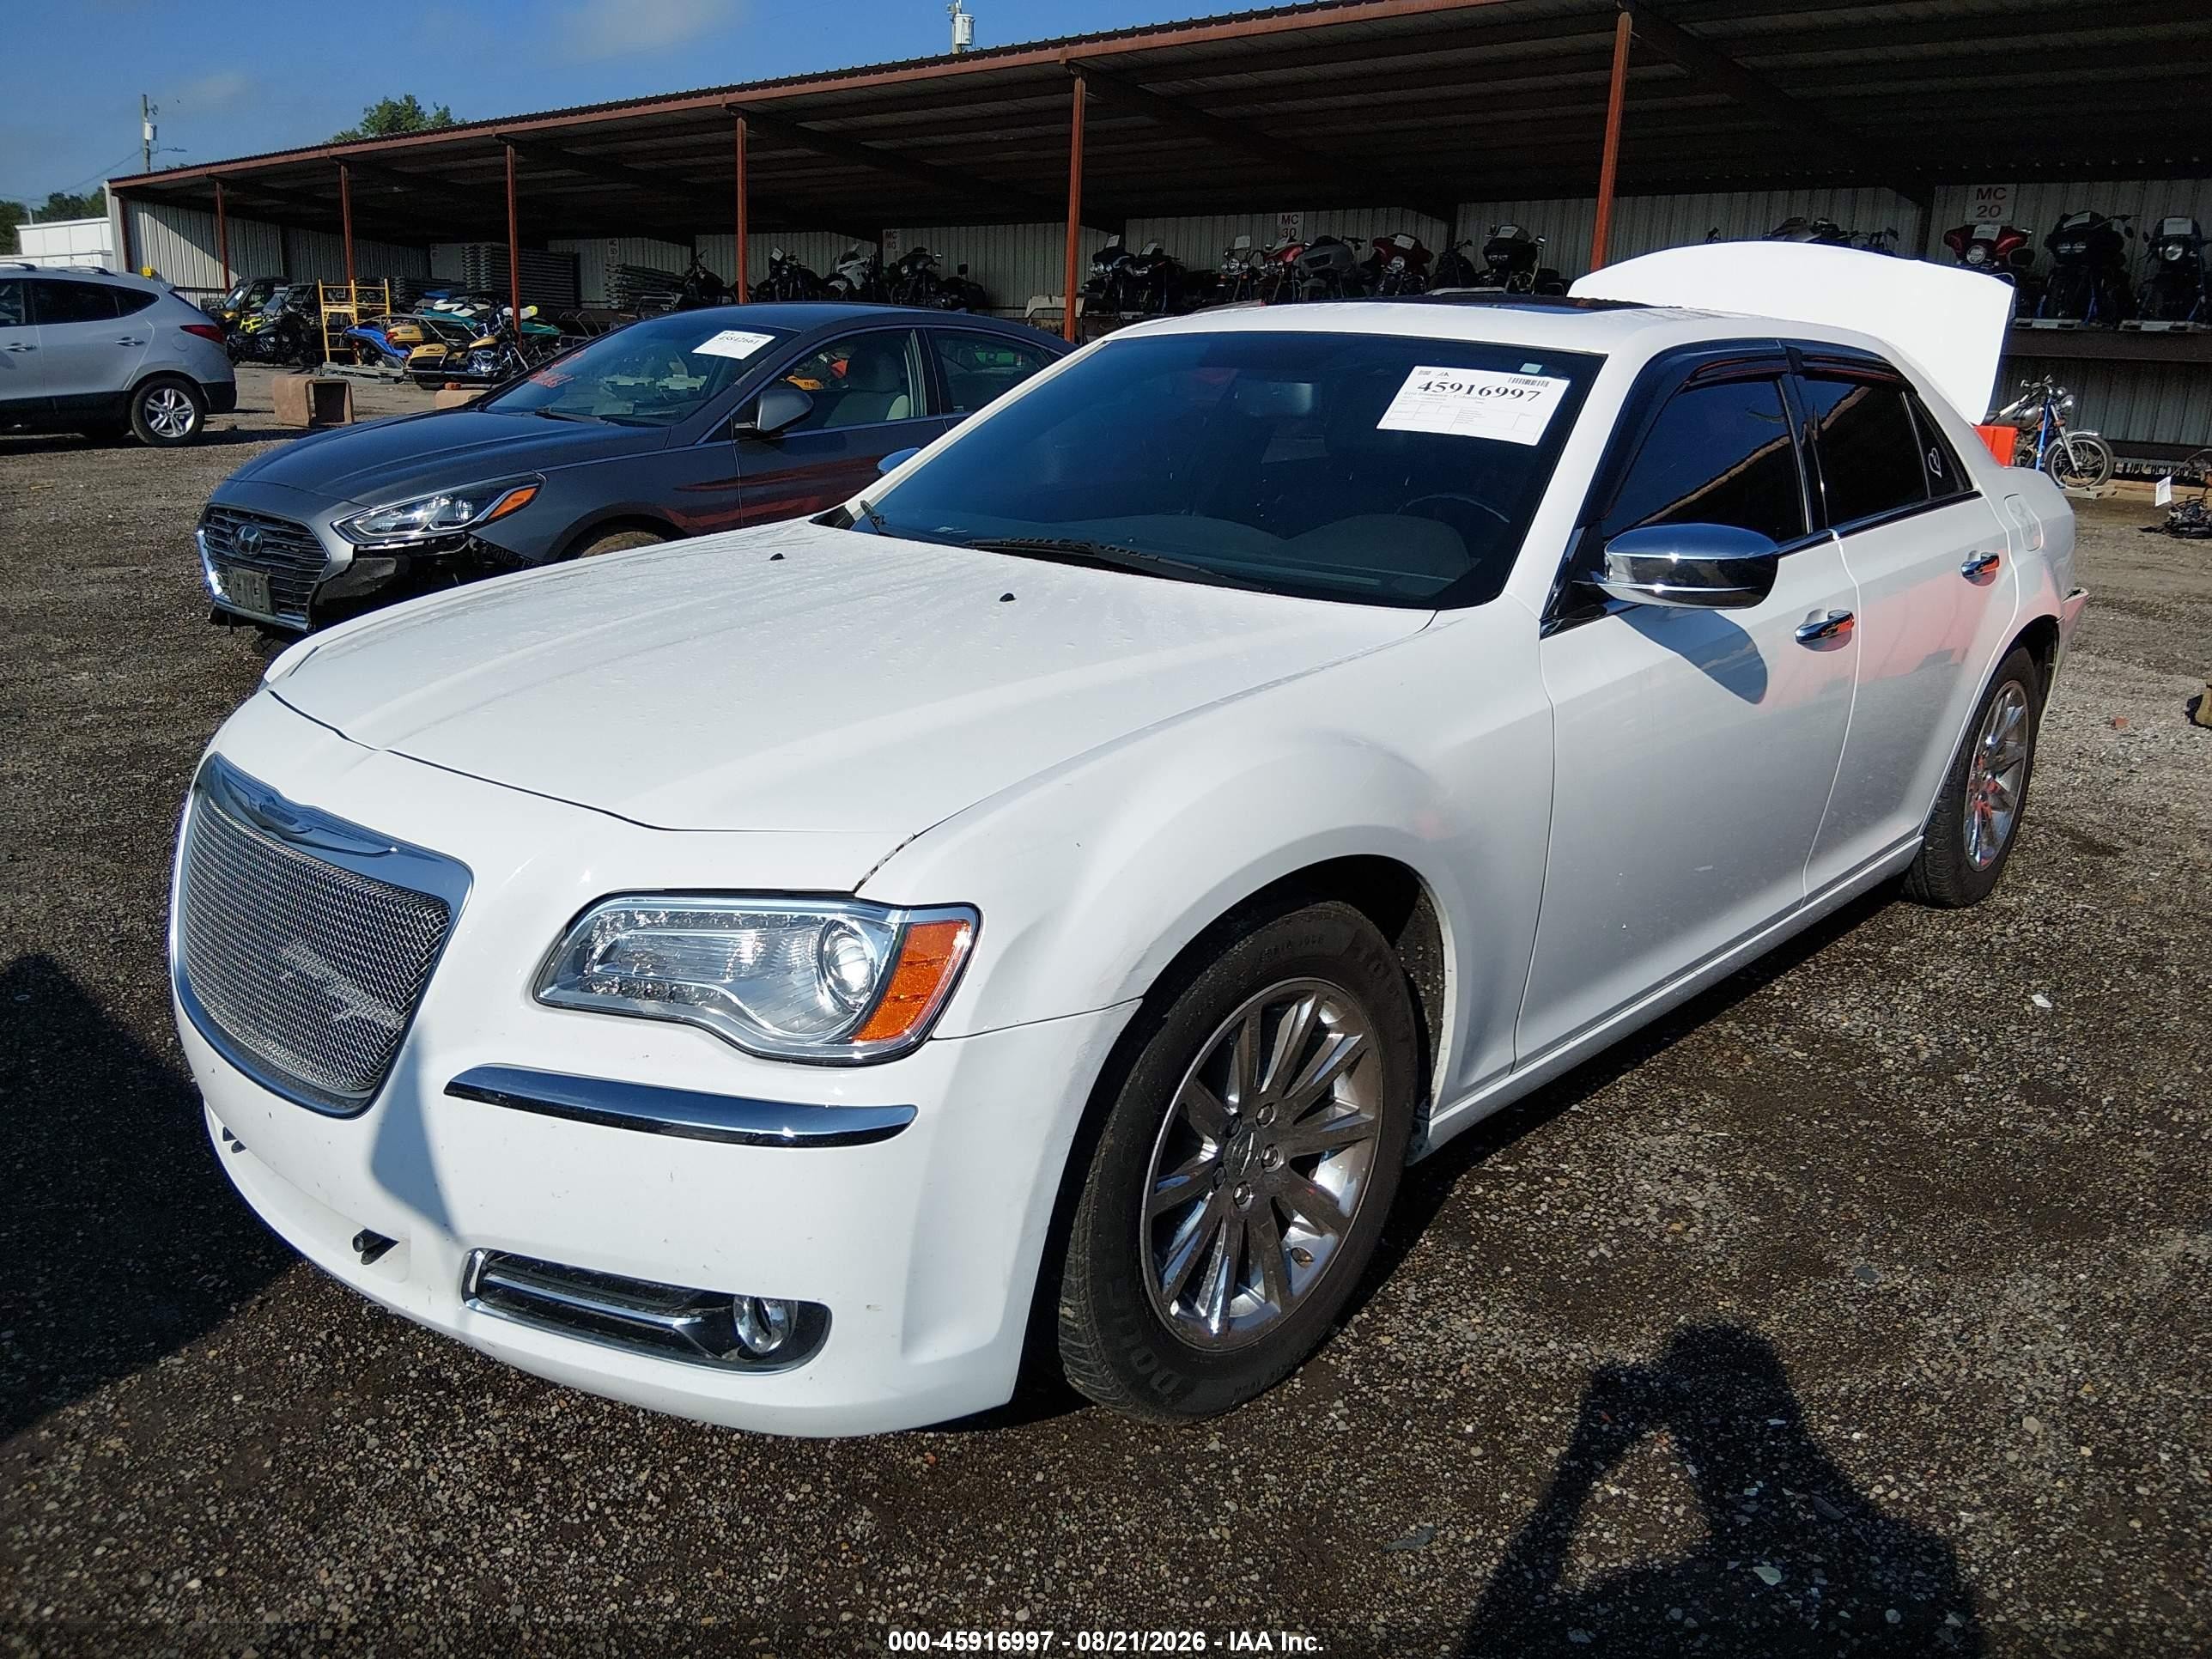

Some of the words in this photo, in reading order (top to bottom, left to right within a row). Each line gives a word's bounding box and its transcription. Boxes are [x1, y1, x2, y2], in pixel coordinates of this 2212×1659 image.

[1976, 187, 2007, 200] MC
[1977, 205, 2002, 218] 20
[1281, 214, 1299, 225] MC
[1281, 228, 1297, 240] 30
[1417, 380, 1541, 403] 45916997
